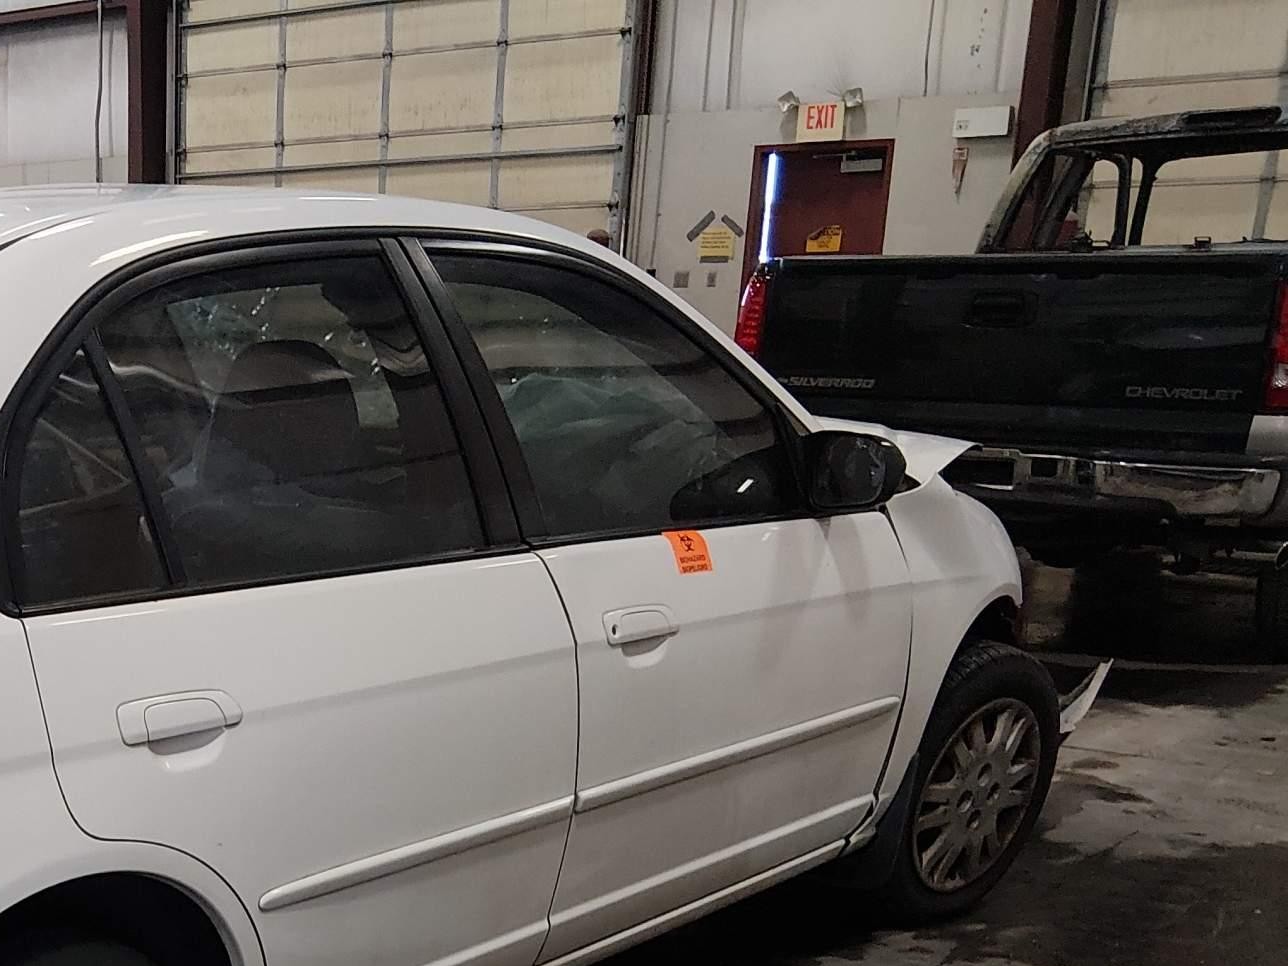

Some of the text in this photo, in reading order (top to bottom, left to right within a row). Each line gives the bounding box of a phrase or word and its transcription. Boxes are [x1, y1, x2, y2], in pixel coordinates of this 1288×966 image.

[806, 104, 838, 130] EXIT
[788, 376, 875, 389] SILVERADO
[1125, 385, 1243, 401] CHEVROLET
